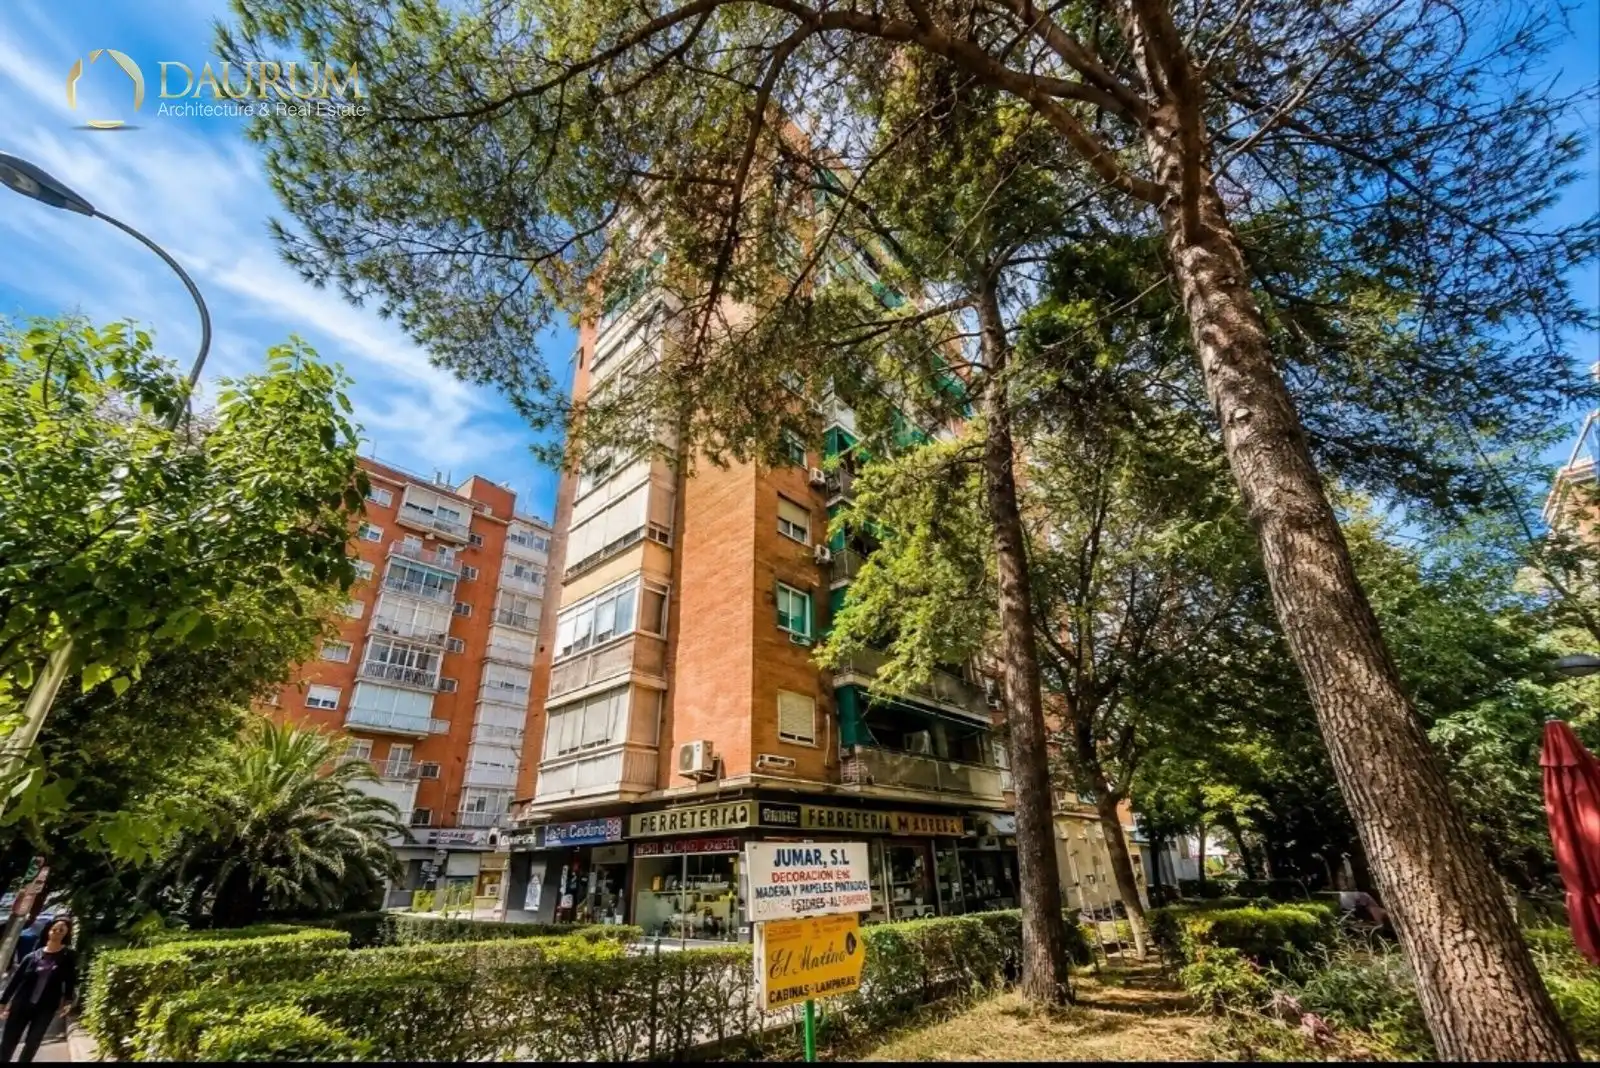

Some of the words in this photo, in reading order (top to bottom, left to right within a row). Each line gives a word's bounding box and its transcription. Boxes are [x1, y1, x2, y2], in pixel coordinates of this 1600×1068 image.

[808, 808, 891, 830] FERRETERIA
[774, 848, 828, 869] JUMAR,
[755, 886, 791, 899] MADERA
[792, 884, 798, 896] Y
[800, 882, 834, 895] PAPELES
[769, 948, 793, 979] El
